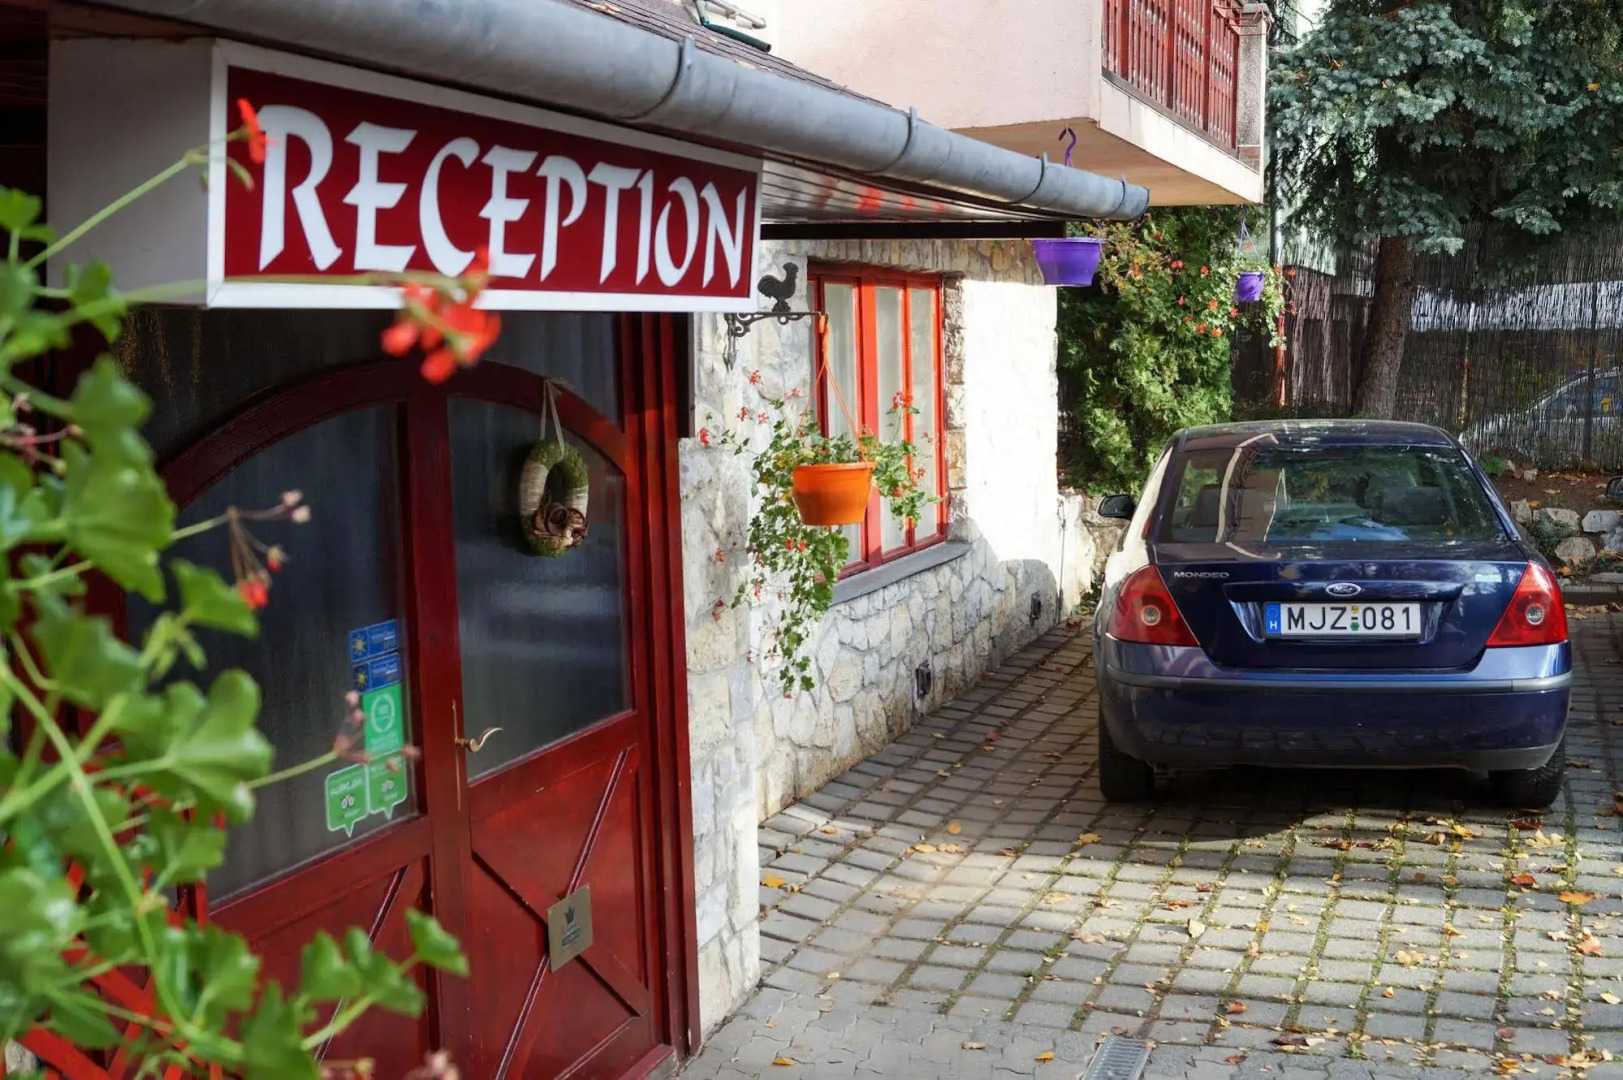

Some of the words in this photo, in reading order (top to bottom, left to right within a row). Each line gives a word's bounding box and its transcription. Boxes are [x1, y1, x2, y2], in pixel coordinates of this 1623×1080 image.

[257, 104, 748, 290] RECEPTION
[1173, 571, 1230, 579] MONDEO
[1269, 620, 1278, 630] H
